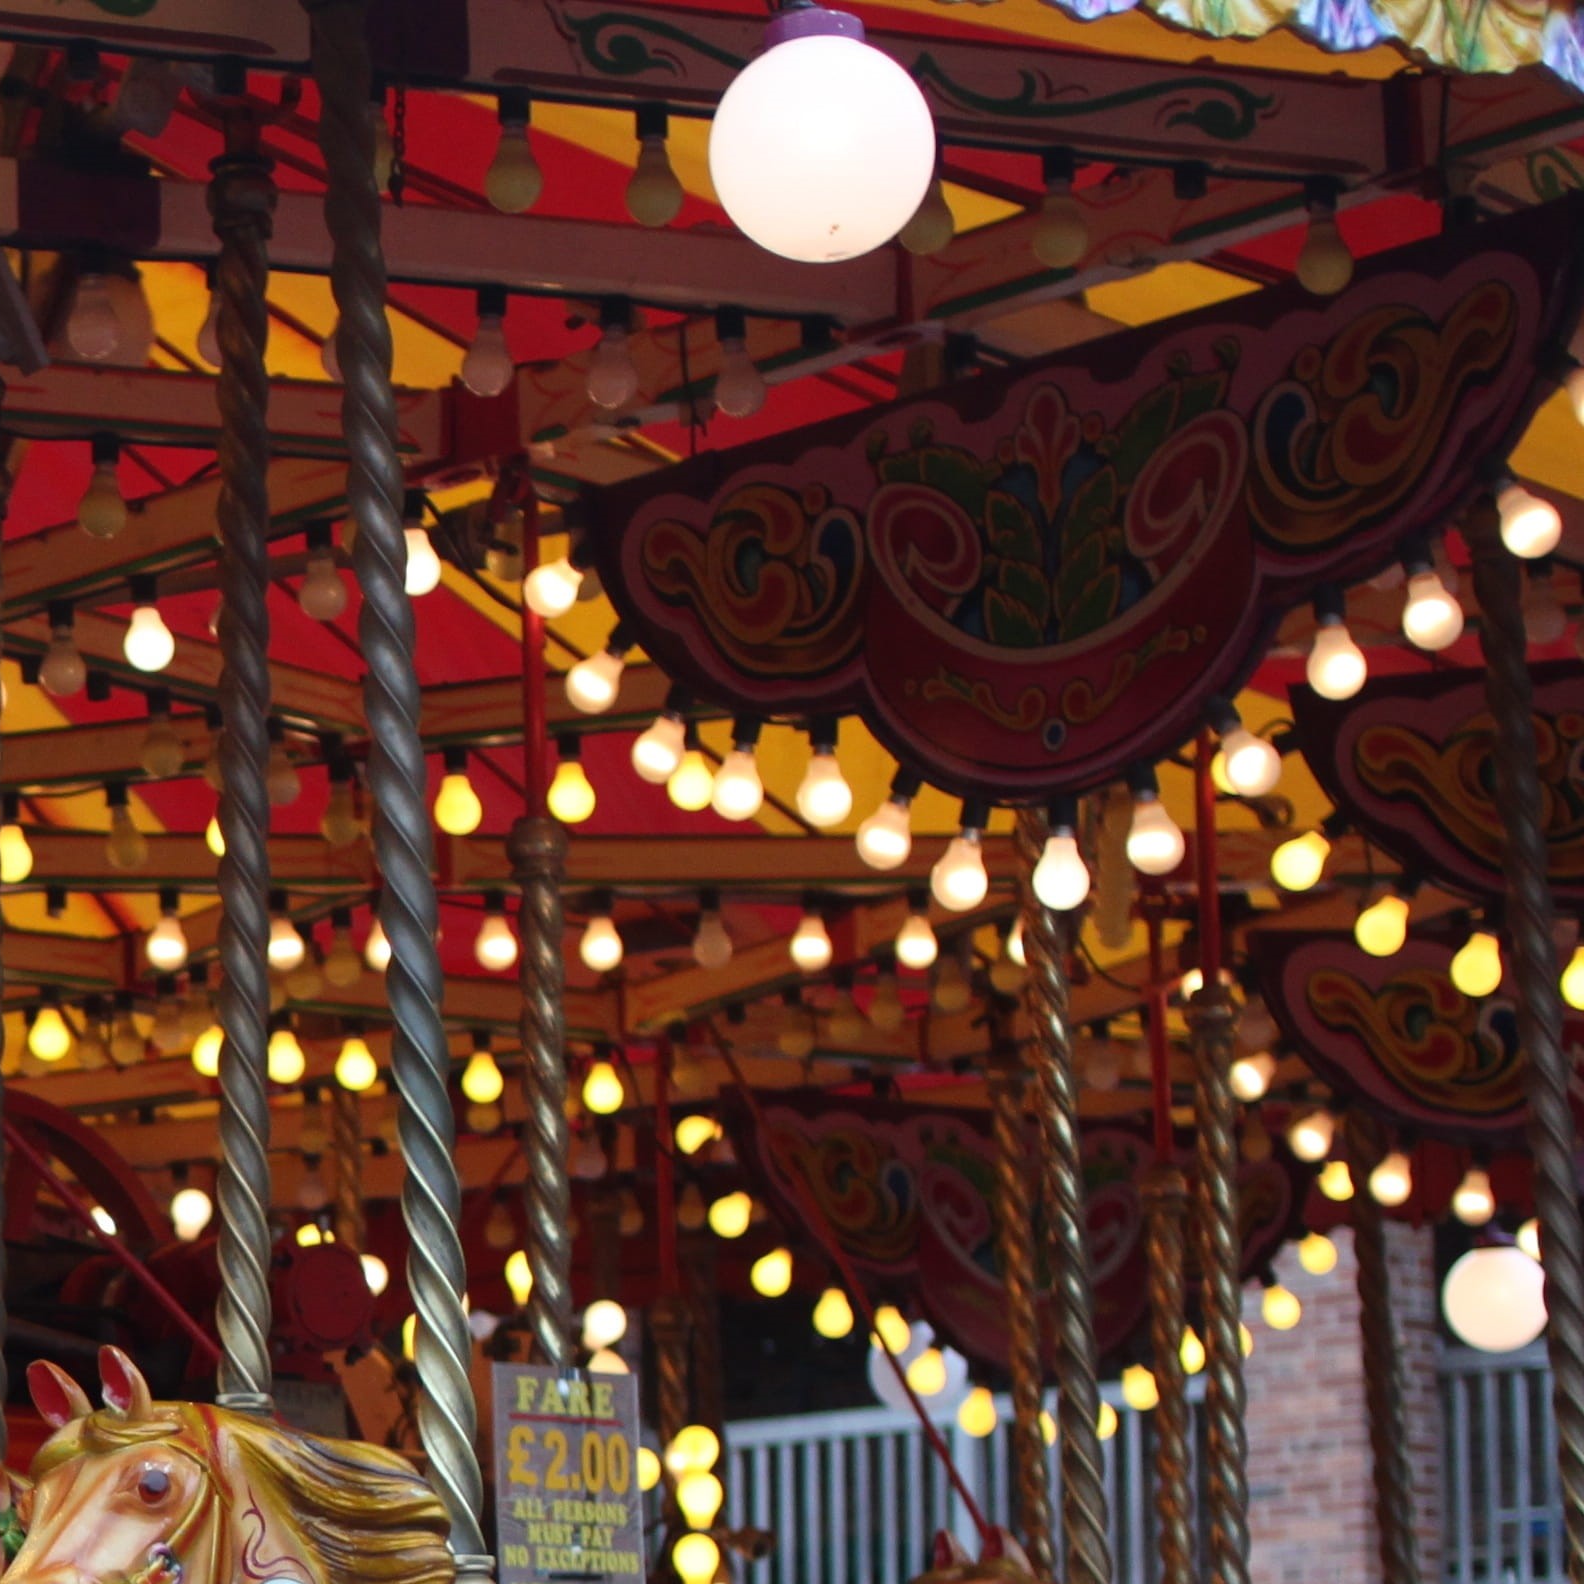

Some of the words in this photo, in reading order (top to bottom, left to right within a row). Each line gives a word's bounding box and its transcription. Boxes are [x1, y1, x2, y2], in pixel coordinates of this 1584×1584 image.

[517, 1376, 615, 1419] FARE
[507, 1425, 629, 1495] £2.00
[512, 1498, 545, 1519] ALL
[553, 1499, 628, 1527] PERSONS
[528, 1522, 573, 1545] MUST
[580, 1525, 615, 1549] PAY
[504, 1545, 529, 1568] NO
[537, 1546, 639, 1574] EXCEPTIONS
